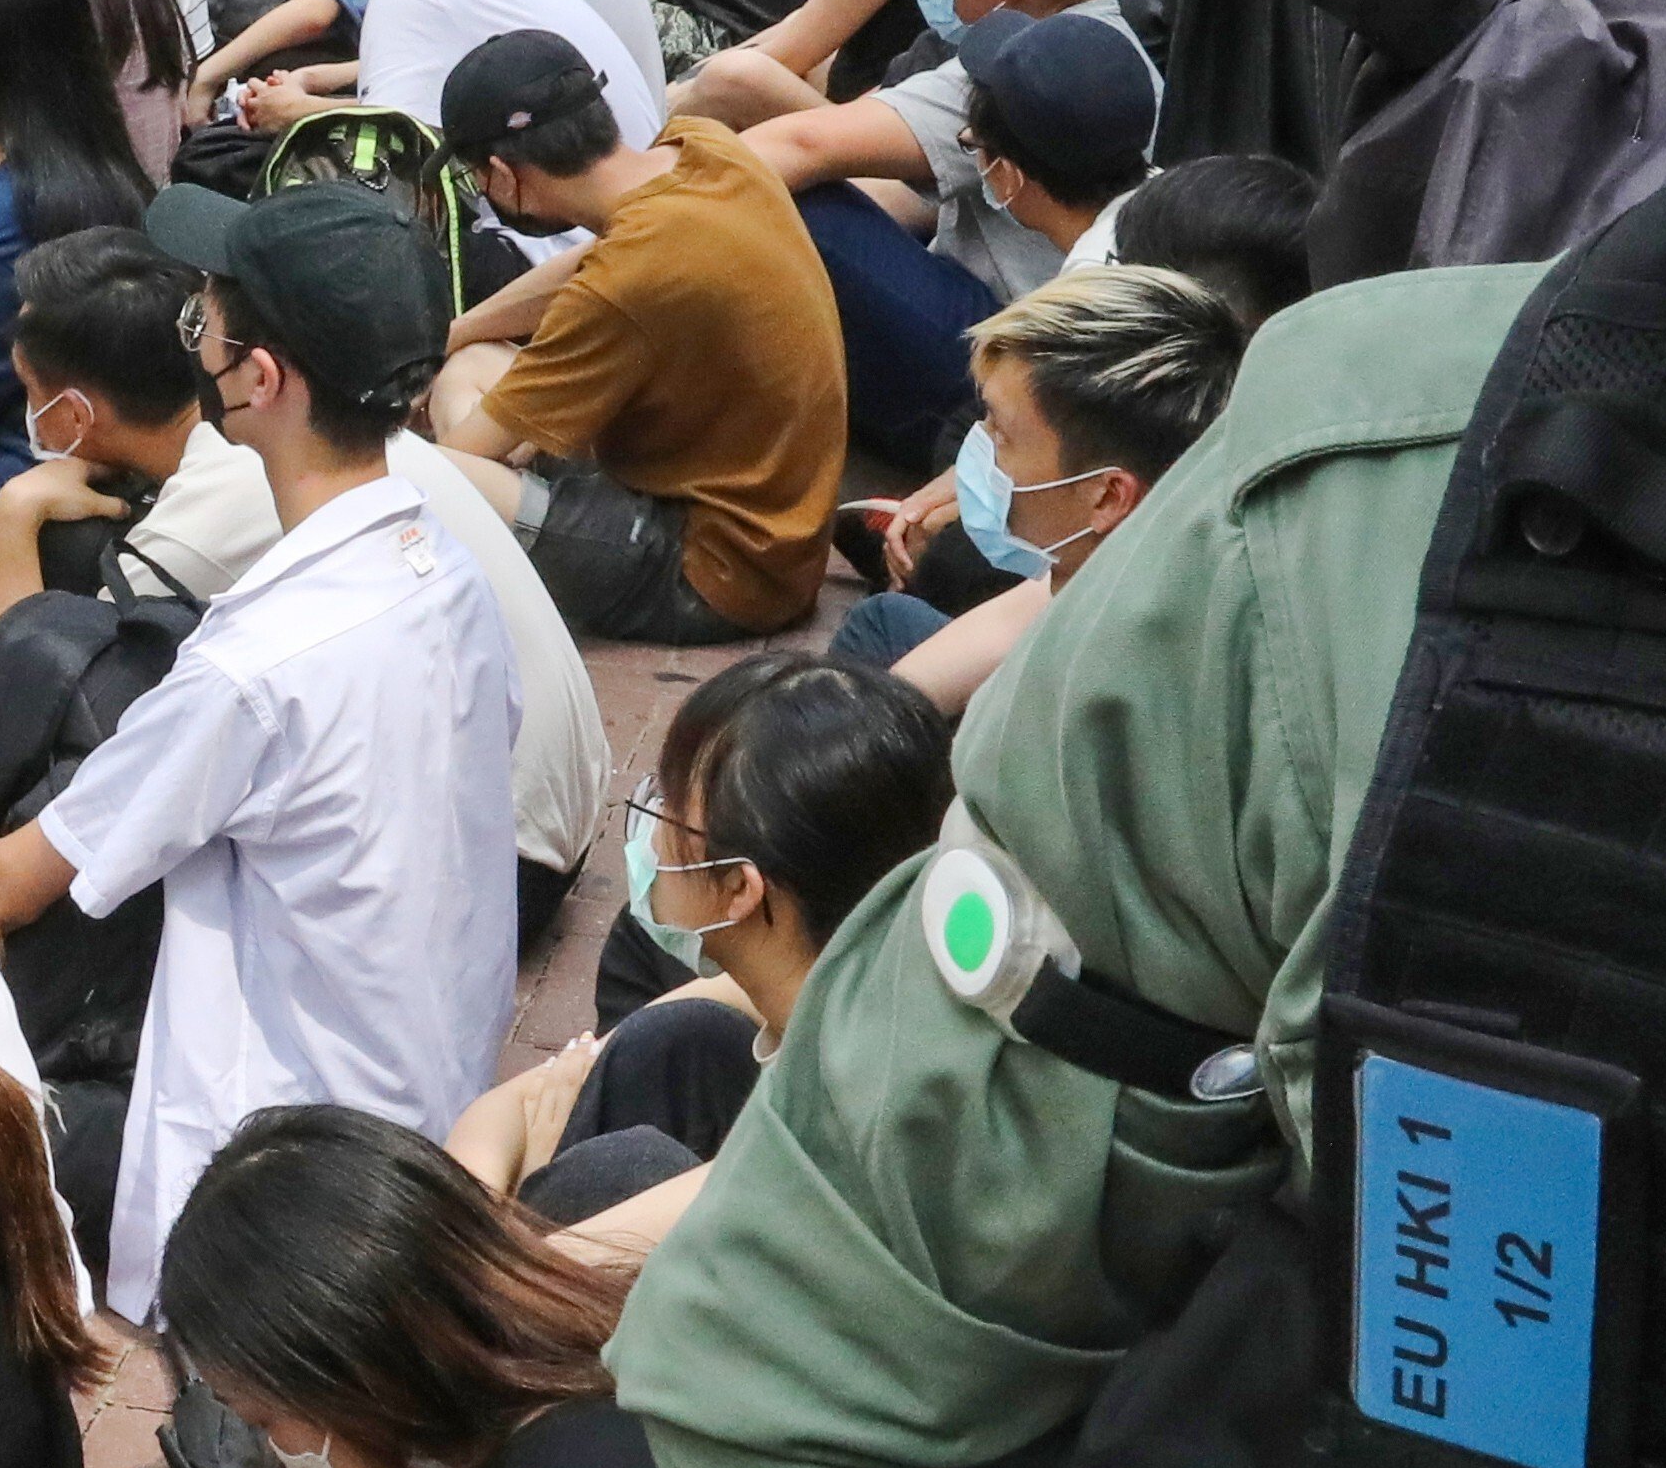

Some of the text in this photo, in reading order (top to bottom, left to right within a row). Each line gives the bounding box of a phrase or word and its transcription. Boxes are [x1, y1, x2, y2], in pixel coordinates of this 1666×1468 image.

[1391, 1113, 1454, 1420] EU HKI 1
[1493, 1230, 1555, 1327] 1/2
